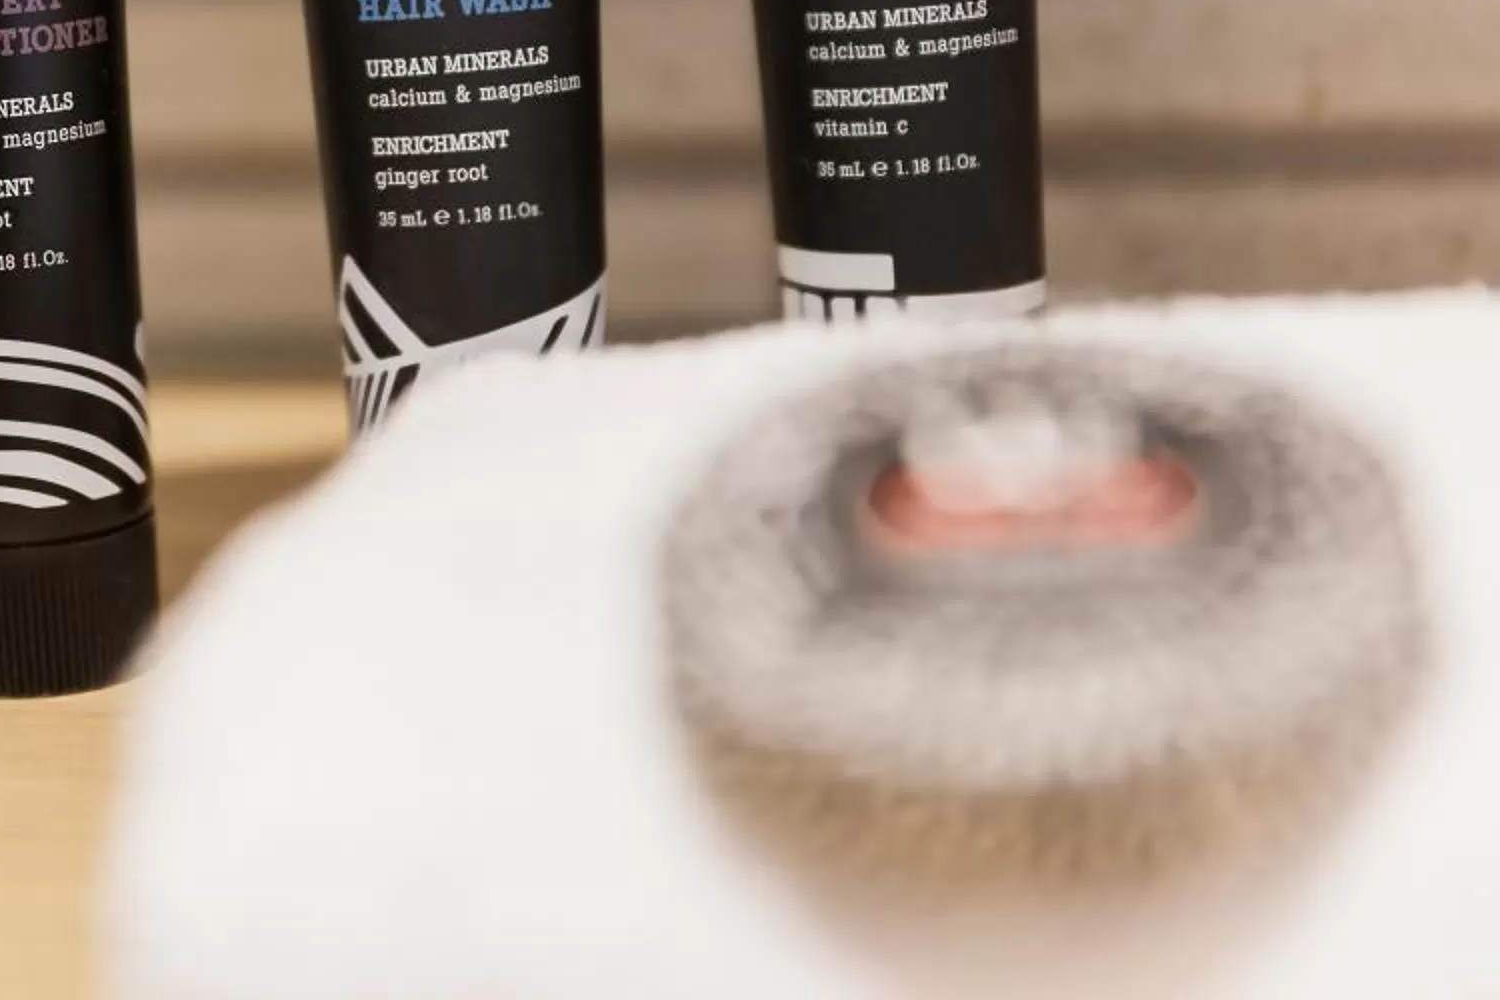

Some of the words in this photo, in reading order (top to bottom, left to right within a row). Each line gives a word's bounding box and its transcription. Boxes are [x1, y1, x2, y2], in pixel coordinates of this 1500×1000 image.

[806, 10, 876, 32] URBAN
[884, 0, 987, 28] MINERALS
[809, 41, 886, 60] calcium
[895, 38, 910, 57] &
[919, 27, 1018, 56] magnesium
[365, 57, 438, 78] URBAN
[443, 45, 549, 74] MINERALS
[368, 89, 447, 108] calcium
[455, 84, 471, 103] &
[480, 73, 581, 103] magnesium
[812, 82, 948, 108] ENRICHMENT
[3, 119, 106, 150] magnesium
[814, 118, 888, 138] vitamin
[896, 120, 908, 134] c
[372, 129, 510, 156] ENRICHMENT
[375, 167, 440, 190] ginger
[448, 163, 488, 183] root
[839, 162, 864, 178] mL
[896, 158, 930, 176] 1.18
[379, 211, 397, 227] 35
[401, 211, 426, 227] mL
[457, 207, 492, 225] 1.18
